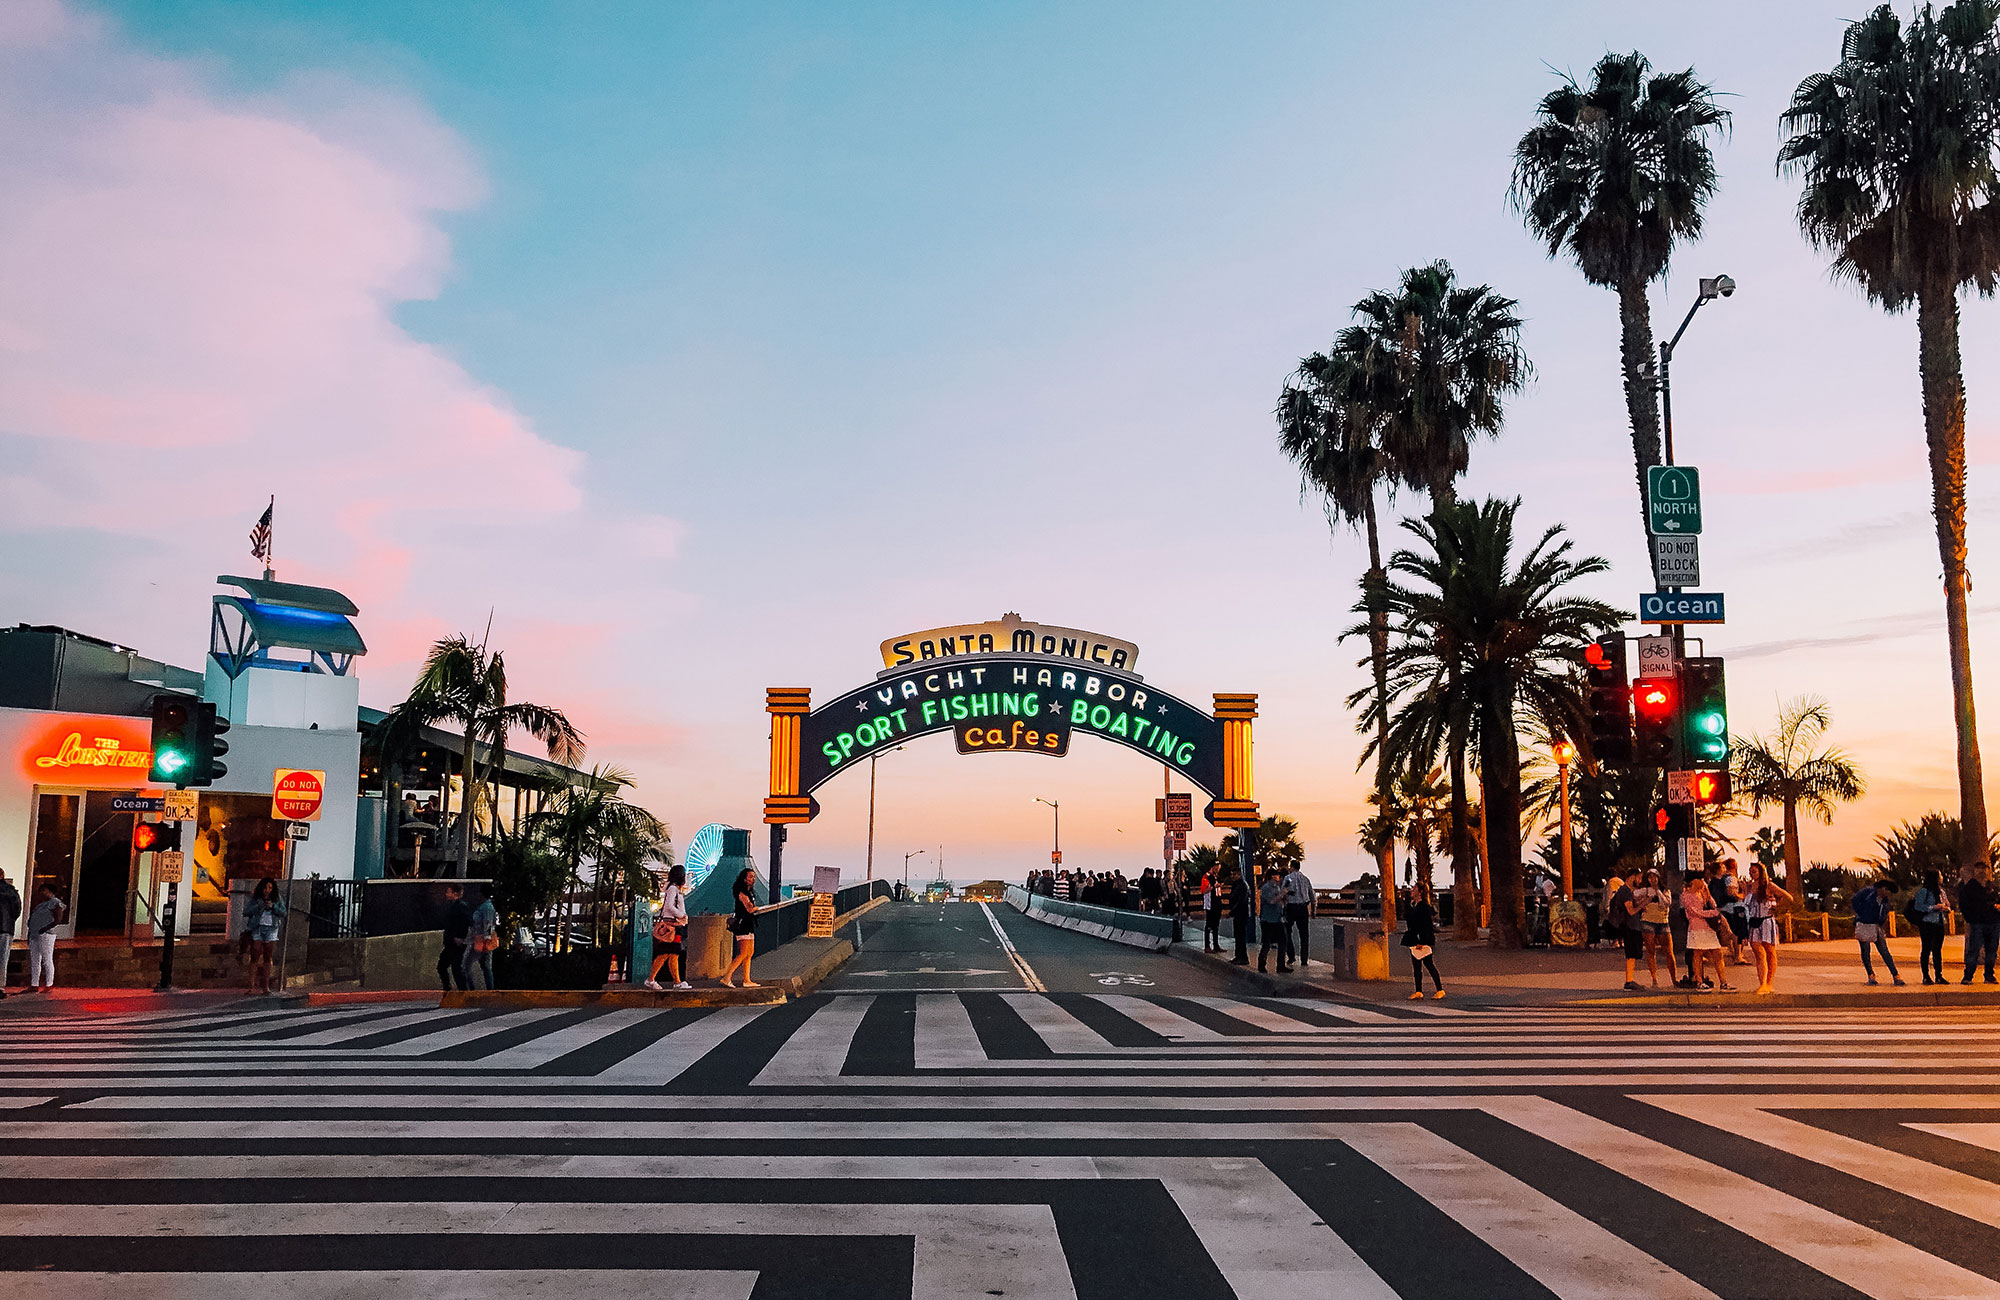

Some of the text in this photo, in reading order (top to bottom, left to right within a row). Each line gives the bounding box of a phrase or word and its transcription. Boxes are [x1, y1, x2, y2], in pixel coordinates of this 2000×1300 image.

[1671, 479, 1677, 494] 1
[1653, 502, 1697, 515] NORTH
[1660, 542, 1695, 554] DO NOT
[1660, 559, 1697, 571] BLOCK
[1660, 573, 1697, 582] INTERSECTION
[1646, 597, 1718, 614] Ocean
[892, 629, 1128, 671] SANTA MONICA
[1642, 663, 1671, 672] SIGNAL
[876, 667, 1148, 711] YACHT HARBOR
[821, 691, 1196, 767] SPORT FISHING BOATING
[964, 720, 1059, 749] cafes
[94, 737, 120, 749] THE
[283, 780, 317, 789] DO NOT
[1669, 788, 1680, 800] OK
[113, 799, 149, 809] Ocean
[283, 801, 312, 811] ENTER
[165, 806, 178, 818] OK
